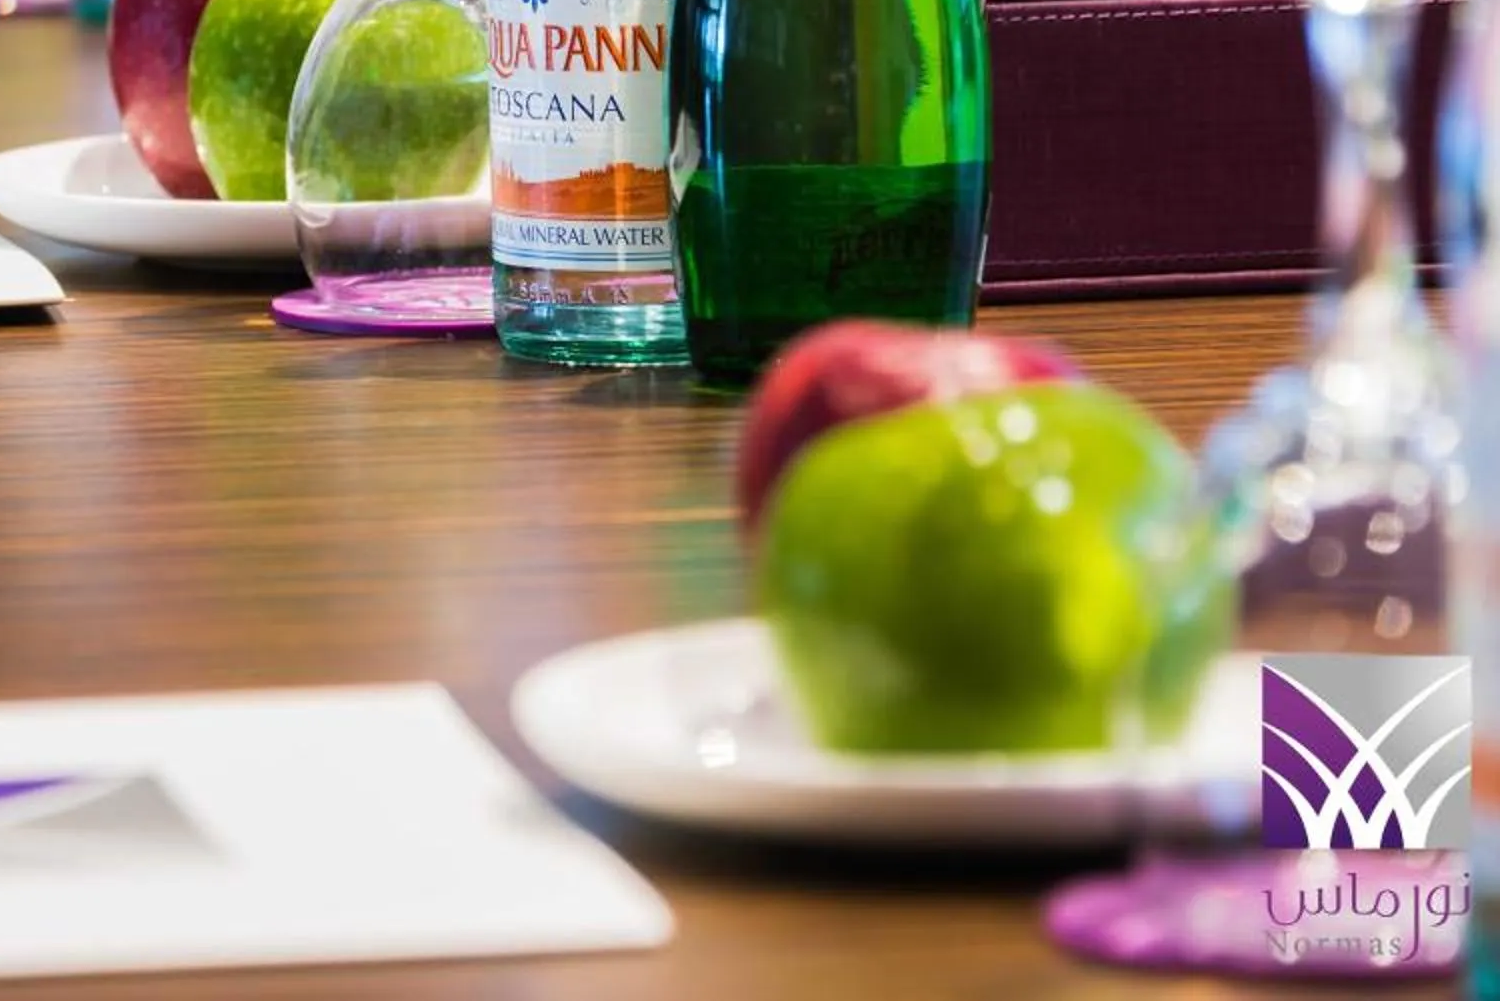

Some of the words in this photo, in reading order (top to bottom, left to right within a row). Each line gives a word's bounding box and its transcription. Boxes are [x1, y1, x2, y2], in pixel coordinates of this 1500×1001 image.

[543, 22, 666, 73] PANN
[492, 86, 626, 123] TOSCANA
[519, 225, 591, 247] MINERAL
[593, 227, 665, 247] WATER
